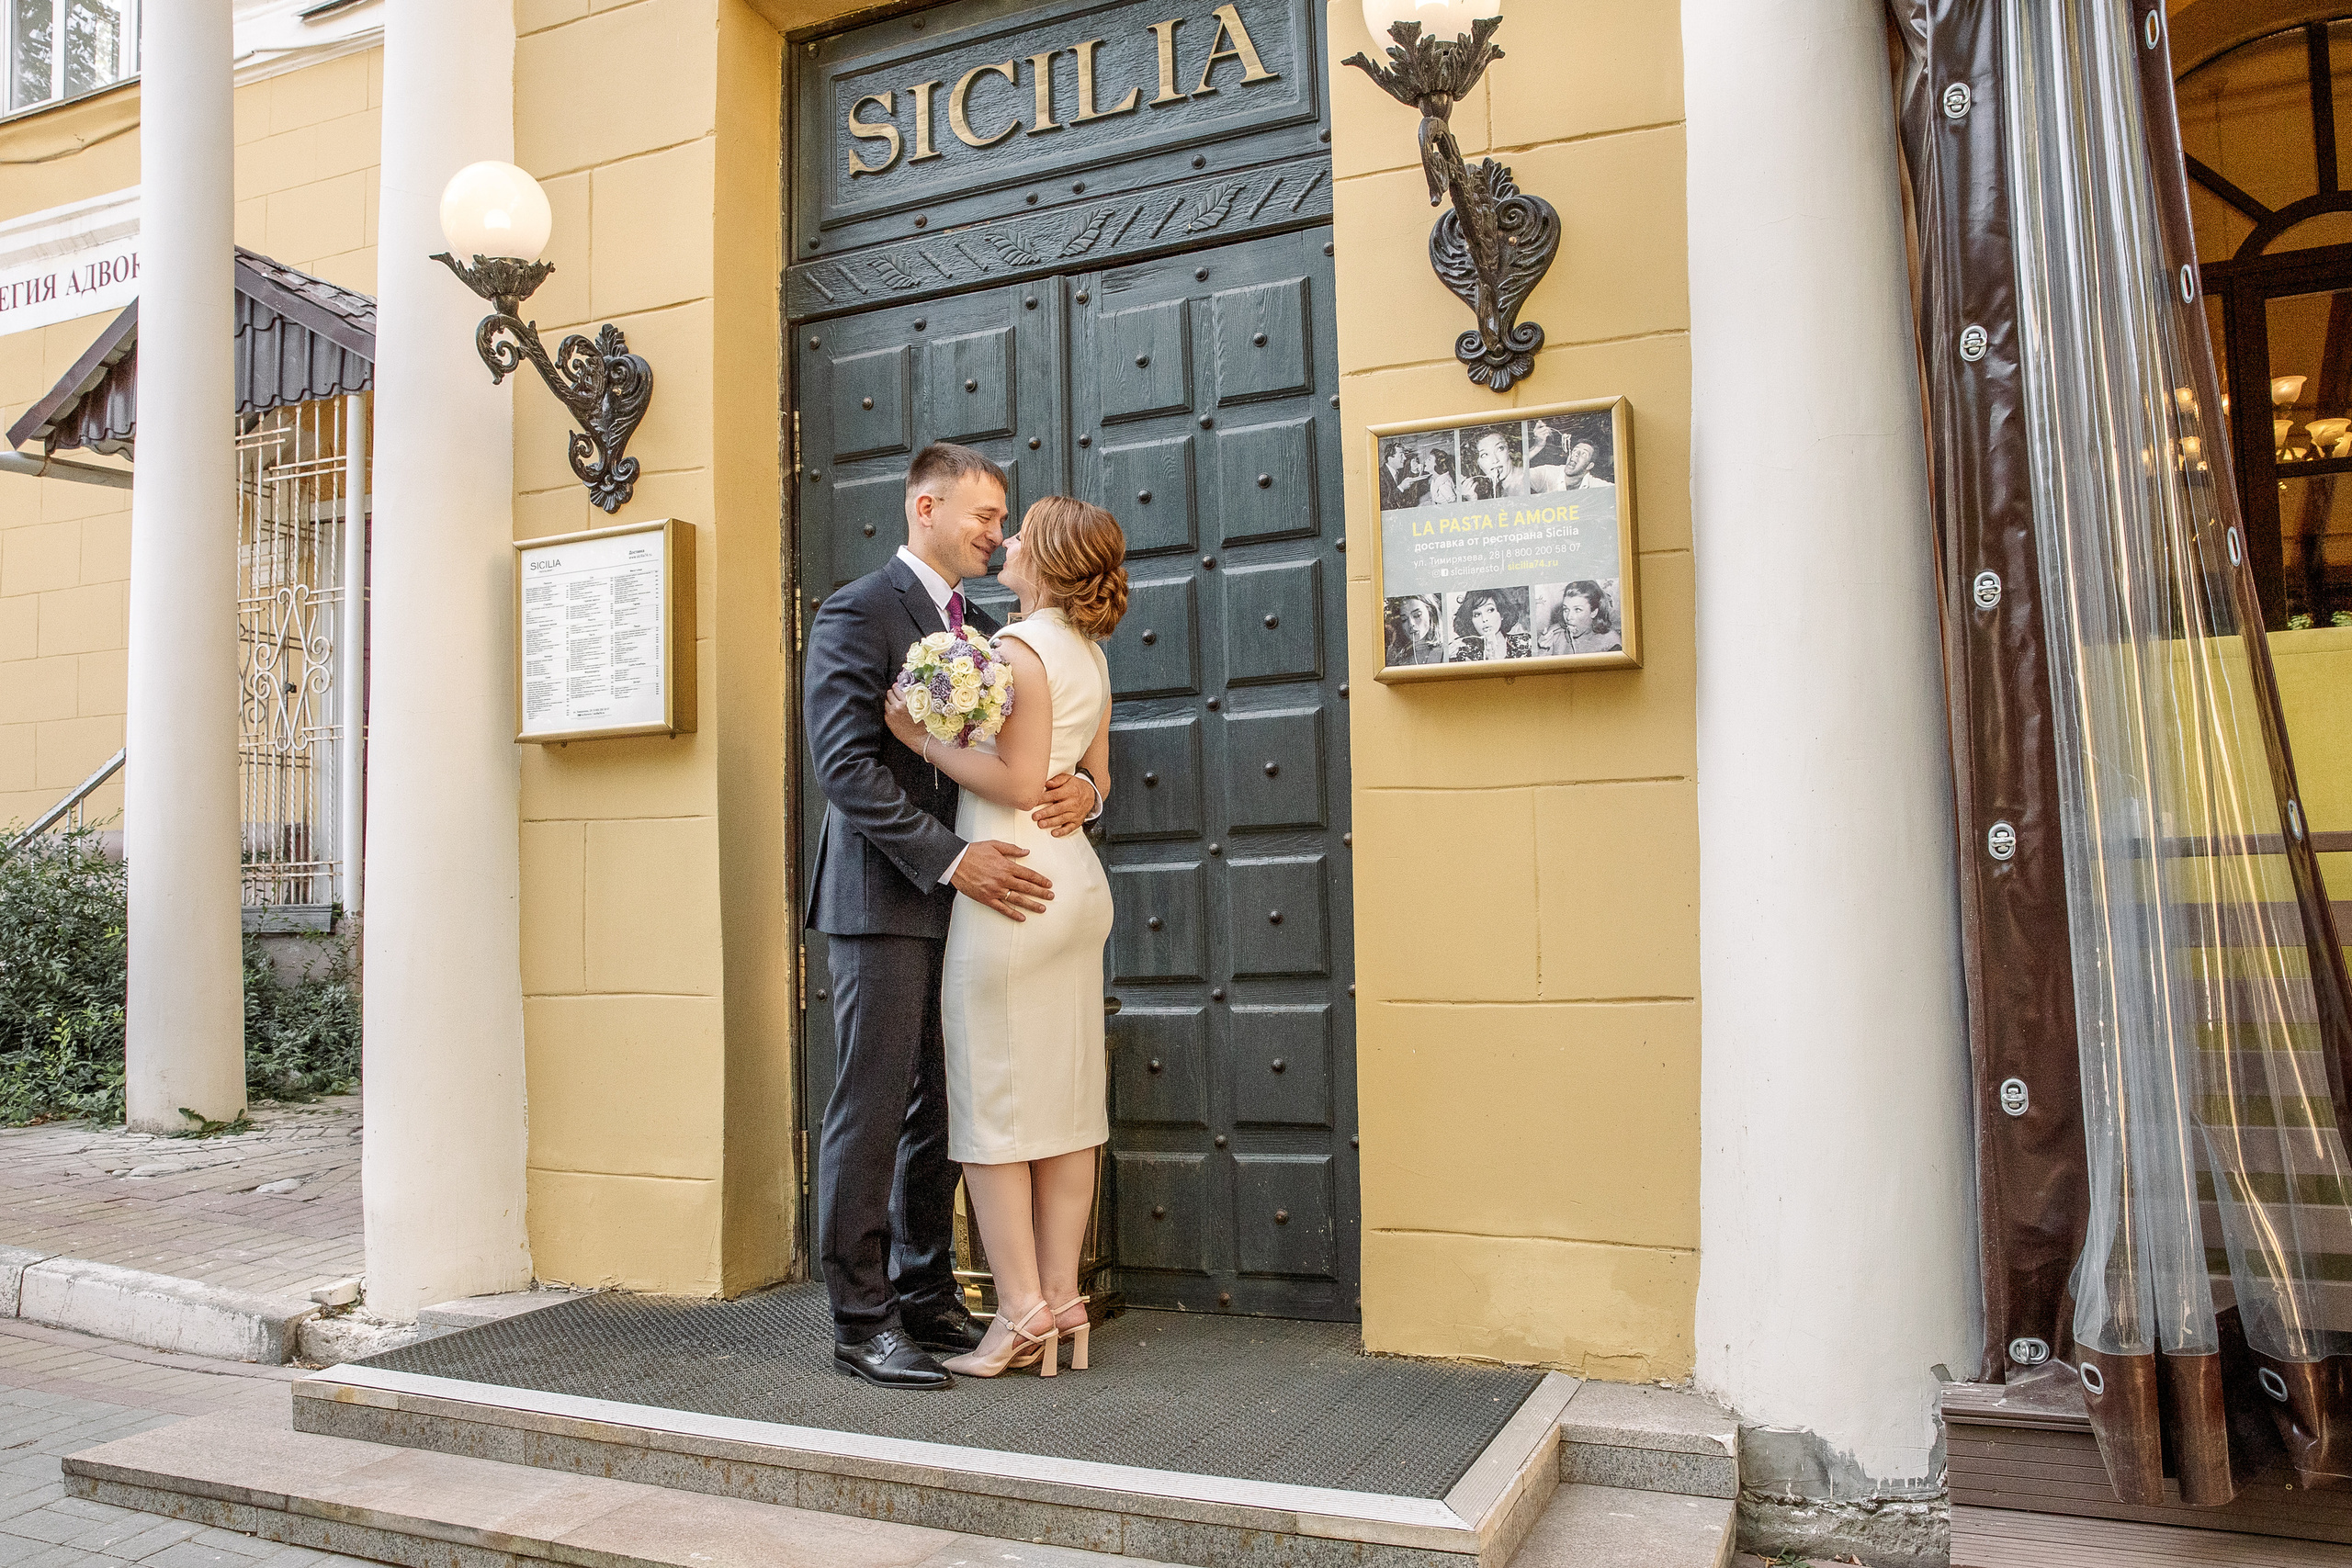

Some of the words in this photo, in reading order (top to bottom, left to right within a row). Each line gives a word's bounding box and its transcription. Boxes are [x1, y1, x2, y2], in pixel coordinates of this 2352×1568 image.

[847, 3, 1279, 177] SICILIA
[1412, 520, 1435, 536] LA
[1440, 514, 1493, 534] PASTA
[1513, 504, 1580, 526] AMORE
[1415, 538, 1464, 552] доставка
[1467, 537, 1479, 547] от
[1483, 531, 1544, 547] ресторана
[1545, 525, 1579, 538] Sicilia
[1506, 548, 1512, 558] 8
[1514, 547, 1532, 557] 800
[1534, 545, 1553, 556] 200
[1555, 544, 1567, 553] 58
[1569, 542, 1581, 552] 07
[530, 558, 562, 570] SICILIA
[1413, 559, 1427, 569] ул.
[1430, 553, 1487, 566] Тимирязева,
[1489, 550, 1500, 560] 28
[1508, 559, 1559, 570] sicilia74.ru
[1450, 564, 1500, 577] siciliaresto
